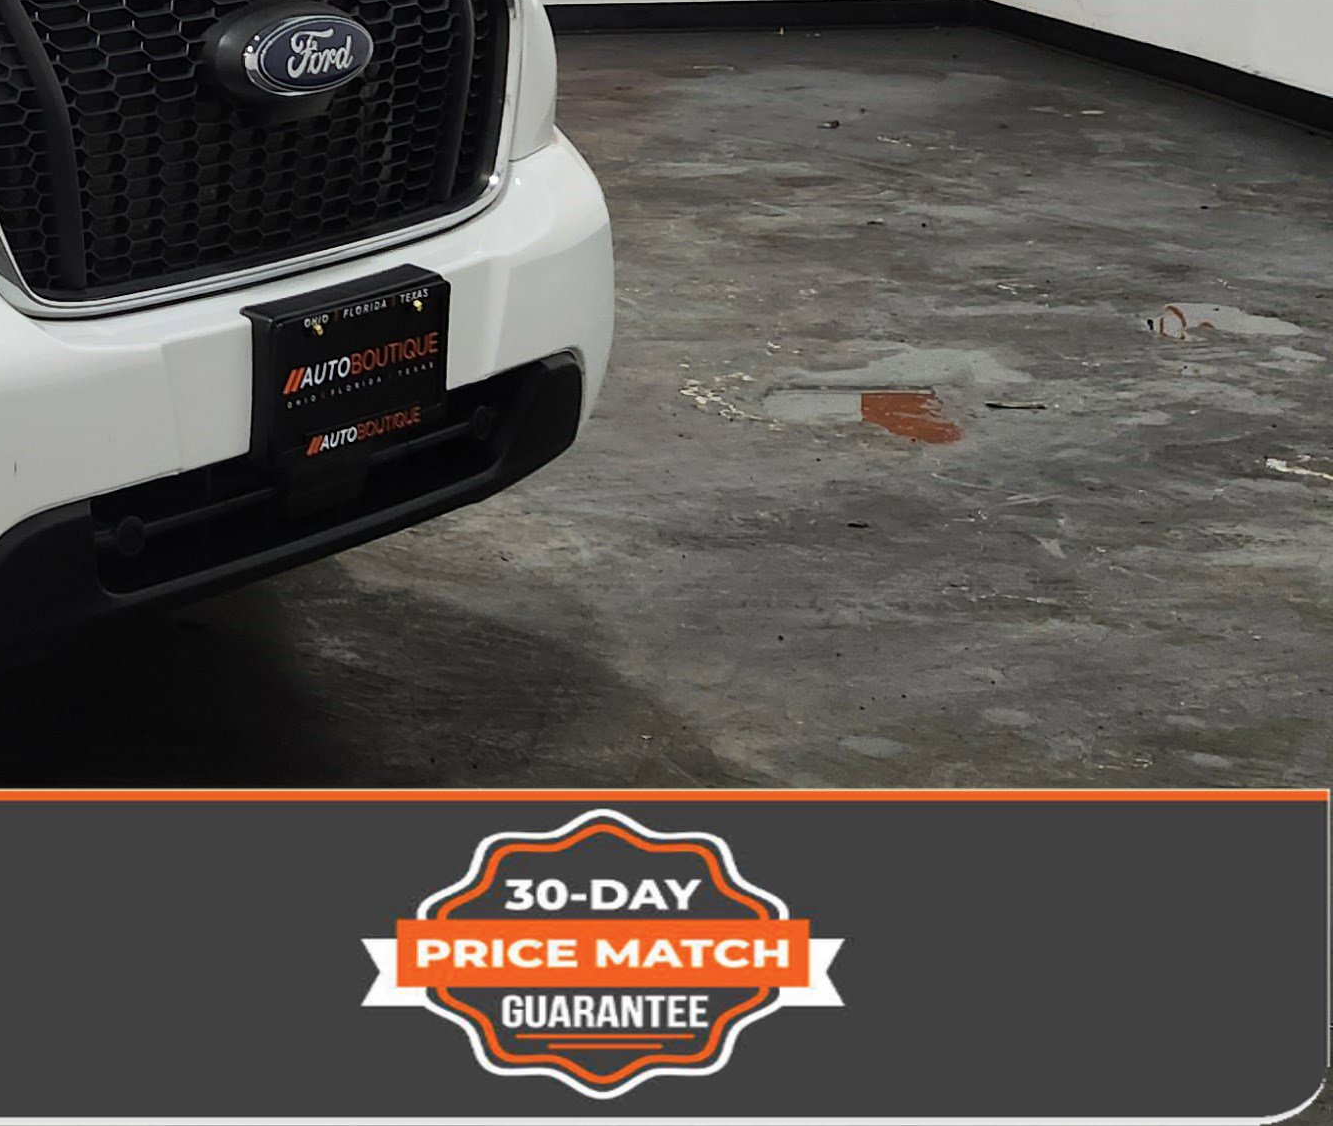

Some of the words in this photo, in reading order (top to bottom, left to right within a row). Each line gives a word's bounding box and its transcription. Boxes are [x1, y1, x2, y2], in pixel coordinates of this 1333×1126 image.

[287, 28, 354, 79] Ford
[303, 314, 329, 328] OHIO
[342, 299, 387, 319] FLORIDA
[399, 288, 429, 304] TEXAS
[300, 331, 439, 389] AUTOBOUTIQUE
[287, 394, 317, 409] OHIO
[330, 376, 382, 396] FLORIDA
[397, 361, 434, 377] TEXAS
[319, 406, 423, 451] AUTOBOUTIQUE
